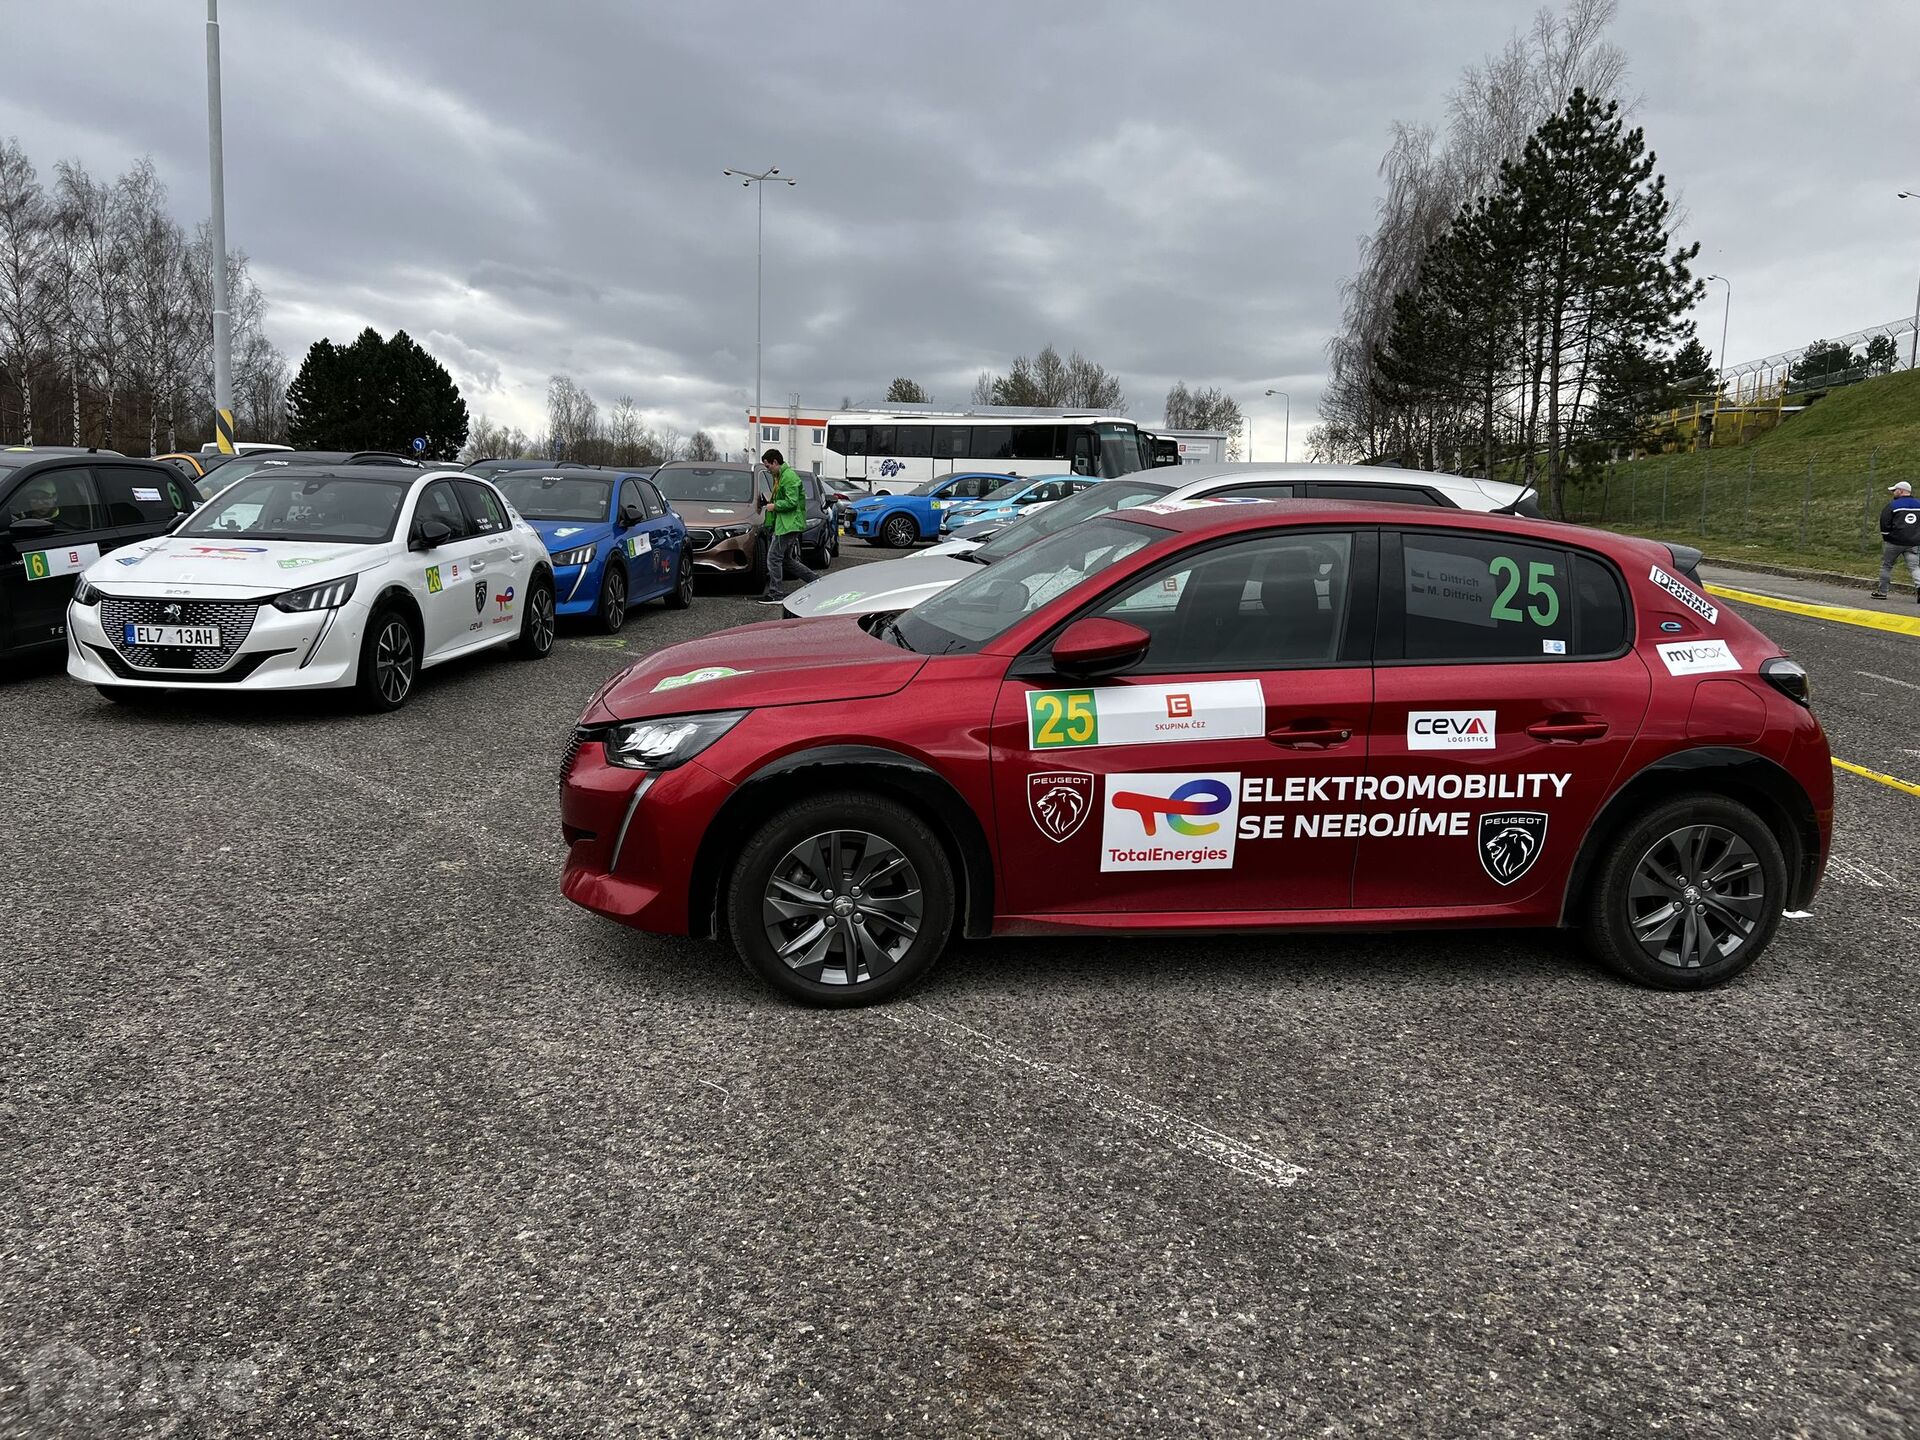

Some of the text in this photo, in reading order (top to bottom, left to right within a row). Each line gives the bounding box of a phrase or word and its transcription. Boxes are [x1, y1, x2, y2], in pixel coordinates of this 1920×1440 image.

[988, 479, 999, 490] 29
[166, 481, 182, 510] 6
[32, 553, 44, 577] 6
[425, 568, 442, 593] 26
[1439, 571, 1480, 588] Dittrich
[1426, 584, 1483, 603] M. Dittrich
[1488, 555, 1561, 627] 25
[1668, 585, 1714, 620] CONTACT
[50, 626, 64, 636] TE
[137, 628, 213, 645] EL7 13AH
[1666, 644, 1727, 664] mybox
[1035, 694, 1095, 745] 25
[1155, 719, 1206, 731] SKUPINA ČEZ
[1447, 736, 1489, 744] LOGISTICS
[1033, 776, 1089, 786] PEUGEOT
[1241, 772, 1573, 803] ELEKTROMOBILITY
[1238, 807, 1471, 840] SE NEBOJÍME
[1485, 817, 1543, 827] PEUGEOT
[1108, 846, 1228, 865] TotalEnergies
